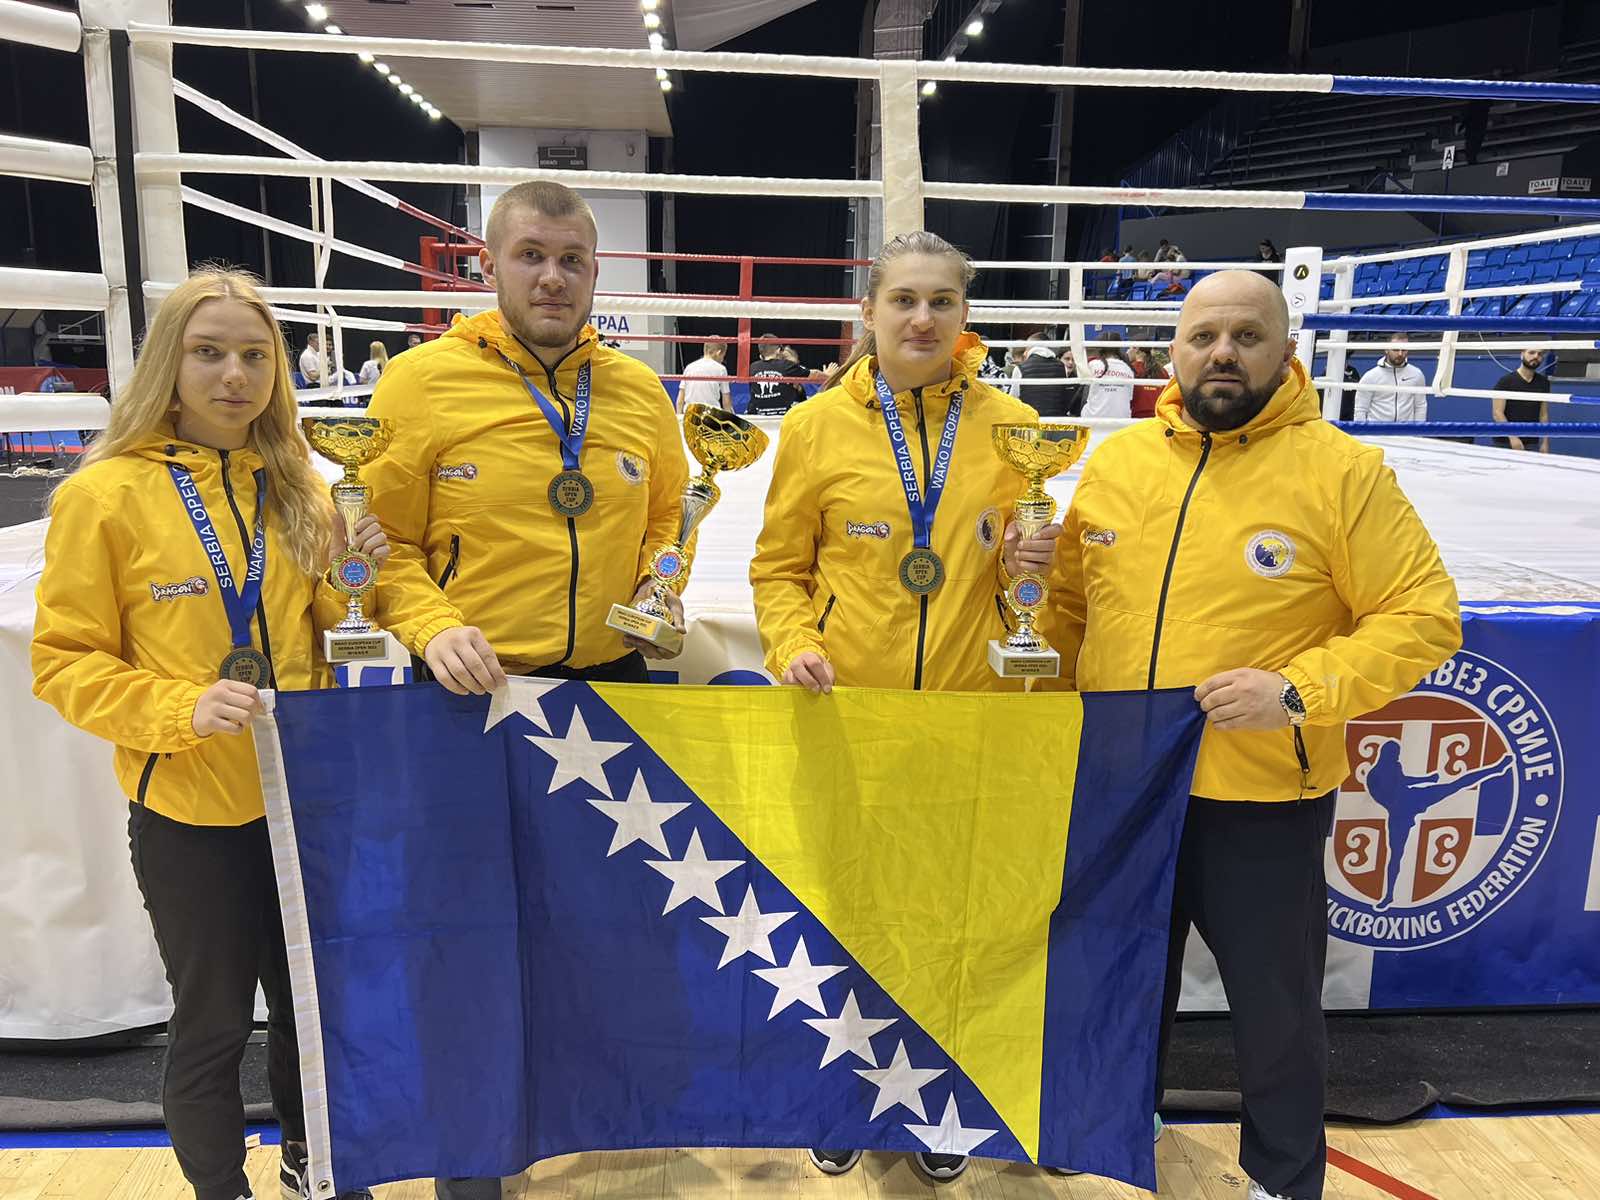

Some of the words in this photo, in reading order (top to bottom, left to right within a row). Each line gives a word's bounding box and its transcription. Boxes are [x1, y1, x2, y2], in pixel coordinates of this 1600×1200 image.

[571, 400, 588, 437] WAKO
[884, 400, 904, 442] OPEN
[896, 444, 920, 502] SERBIA
[931, 450, 950, 489] WAKO
[177, 475, 207, 521] OPEN
[200, 524, 233, 588] SERBIA
[247, 537, 264, 581] WAKO
[151, 583, 192, 601] DRAGON
[1486, 684, 1555, 781] СРБИЈЕ
[1446, 816, 1548, 926] FEDERATION
